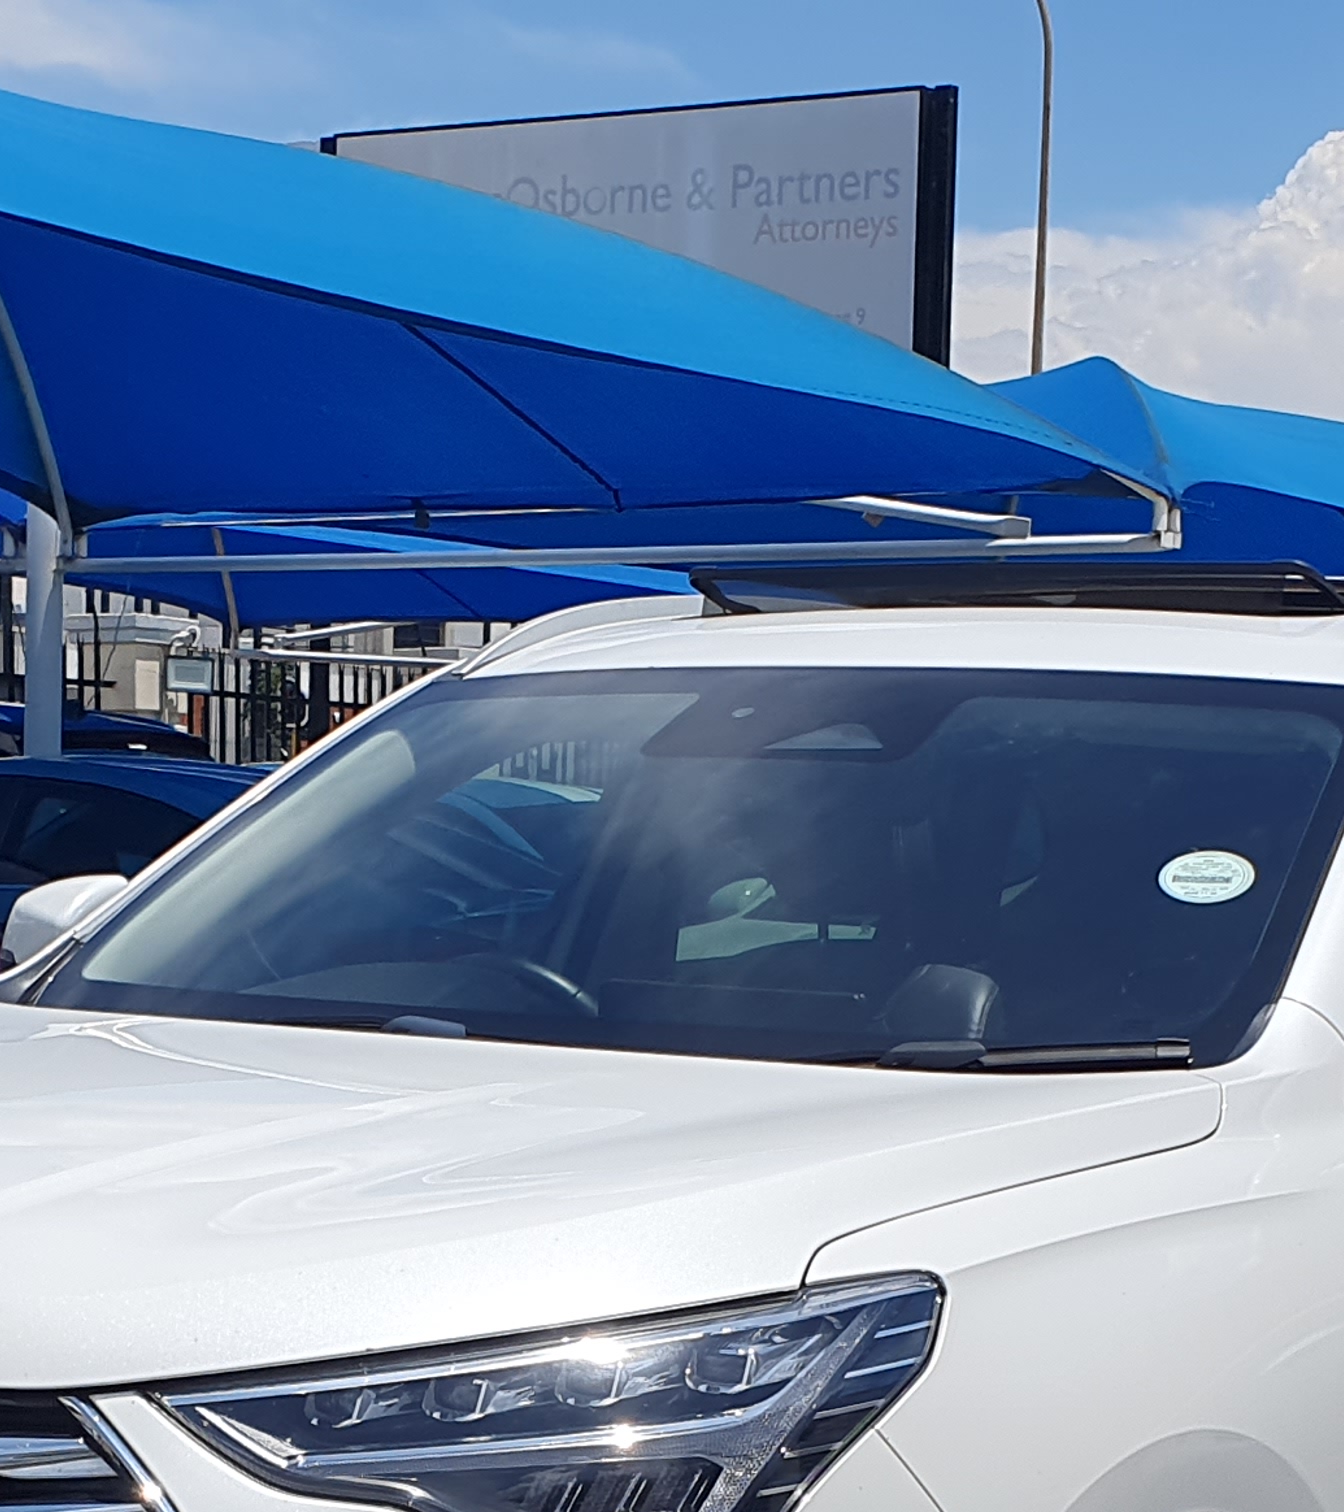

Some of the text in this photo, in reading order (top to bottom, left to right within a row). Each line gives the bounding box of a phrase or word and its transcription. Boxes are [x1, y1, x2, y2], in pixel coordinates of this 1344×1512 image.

[506, 162, 901, 217] Osborne & Partners
[753, 212, 899, 248] Attorneys
